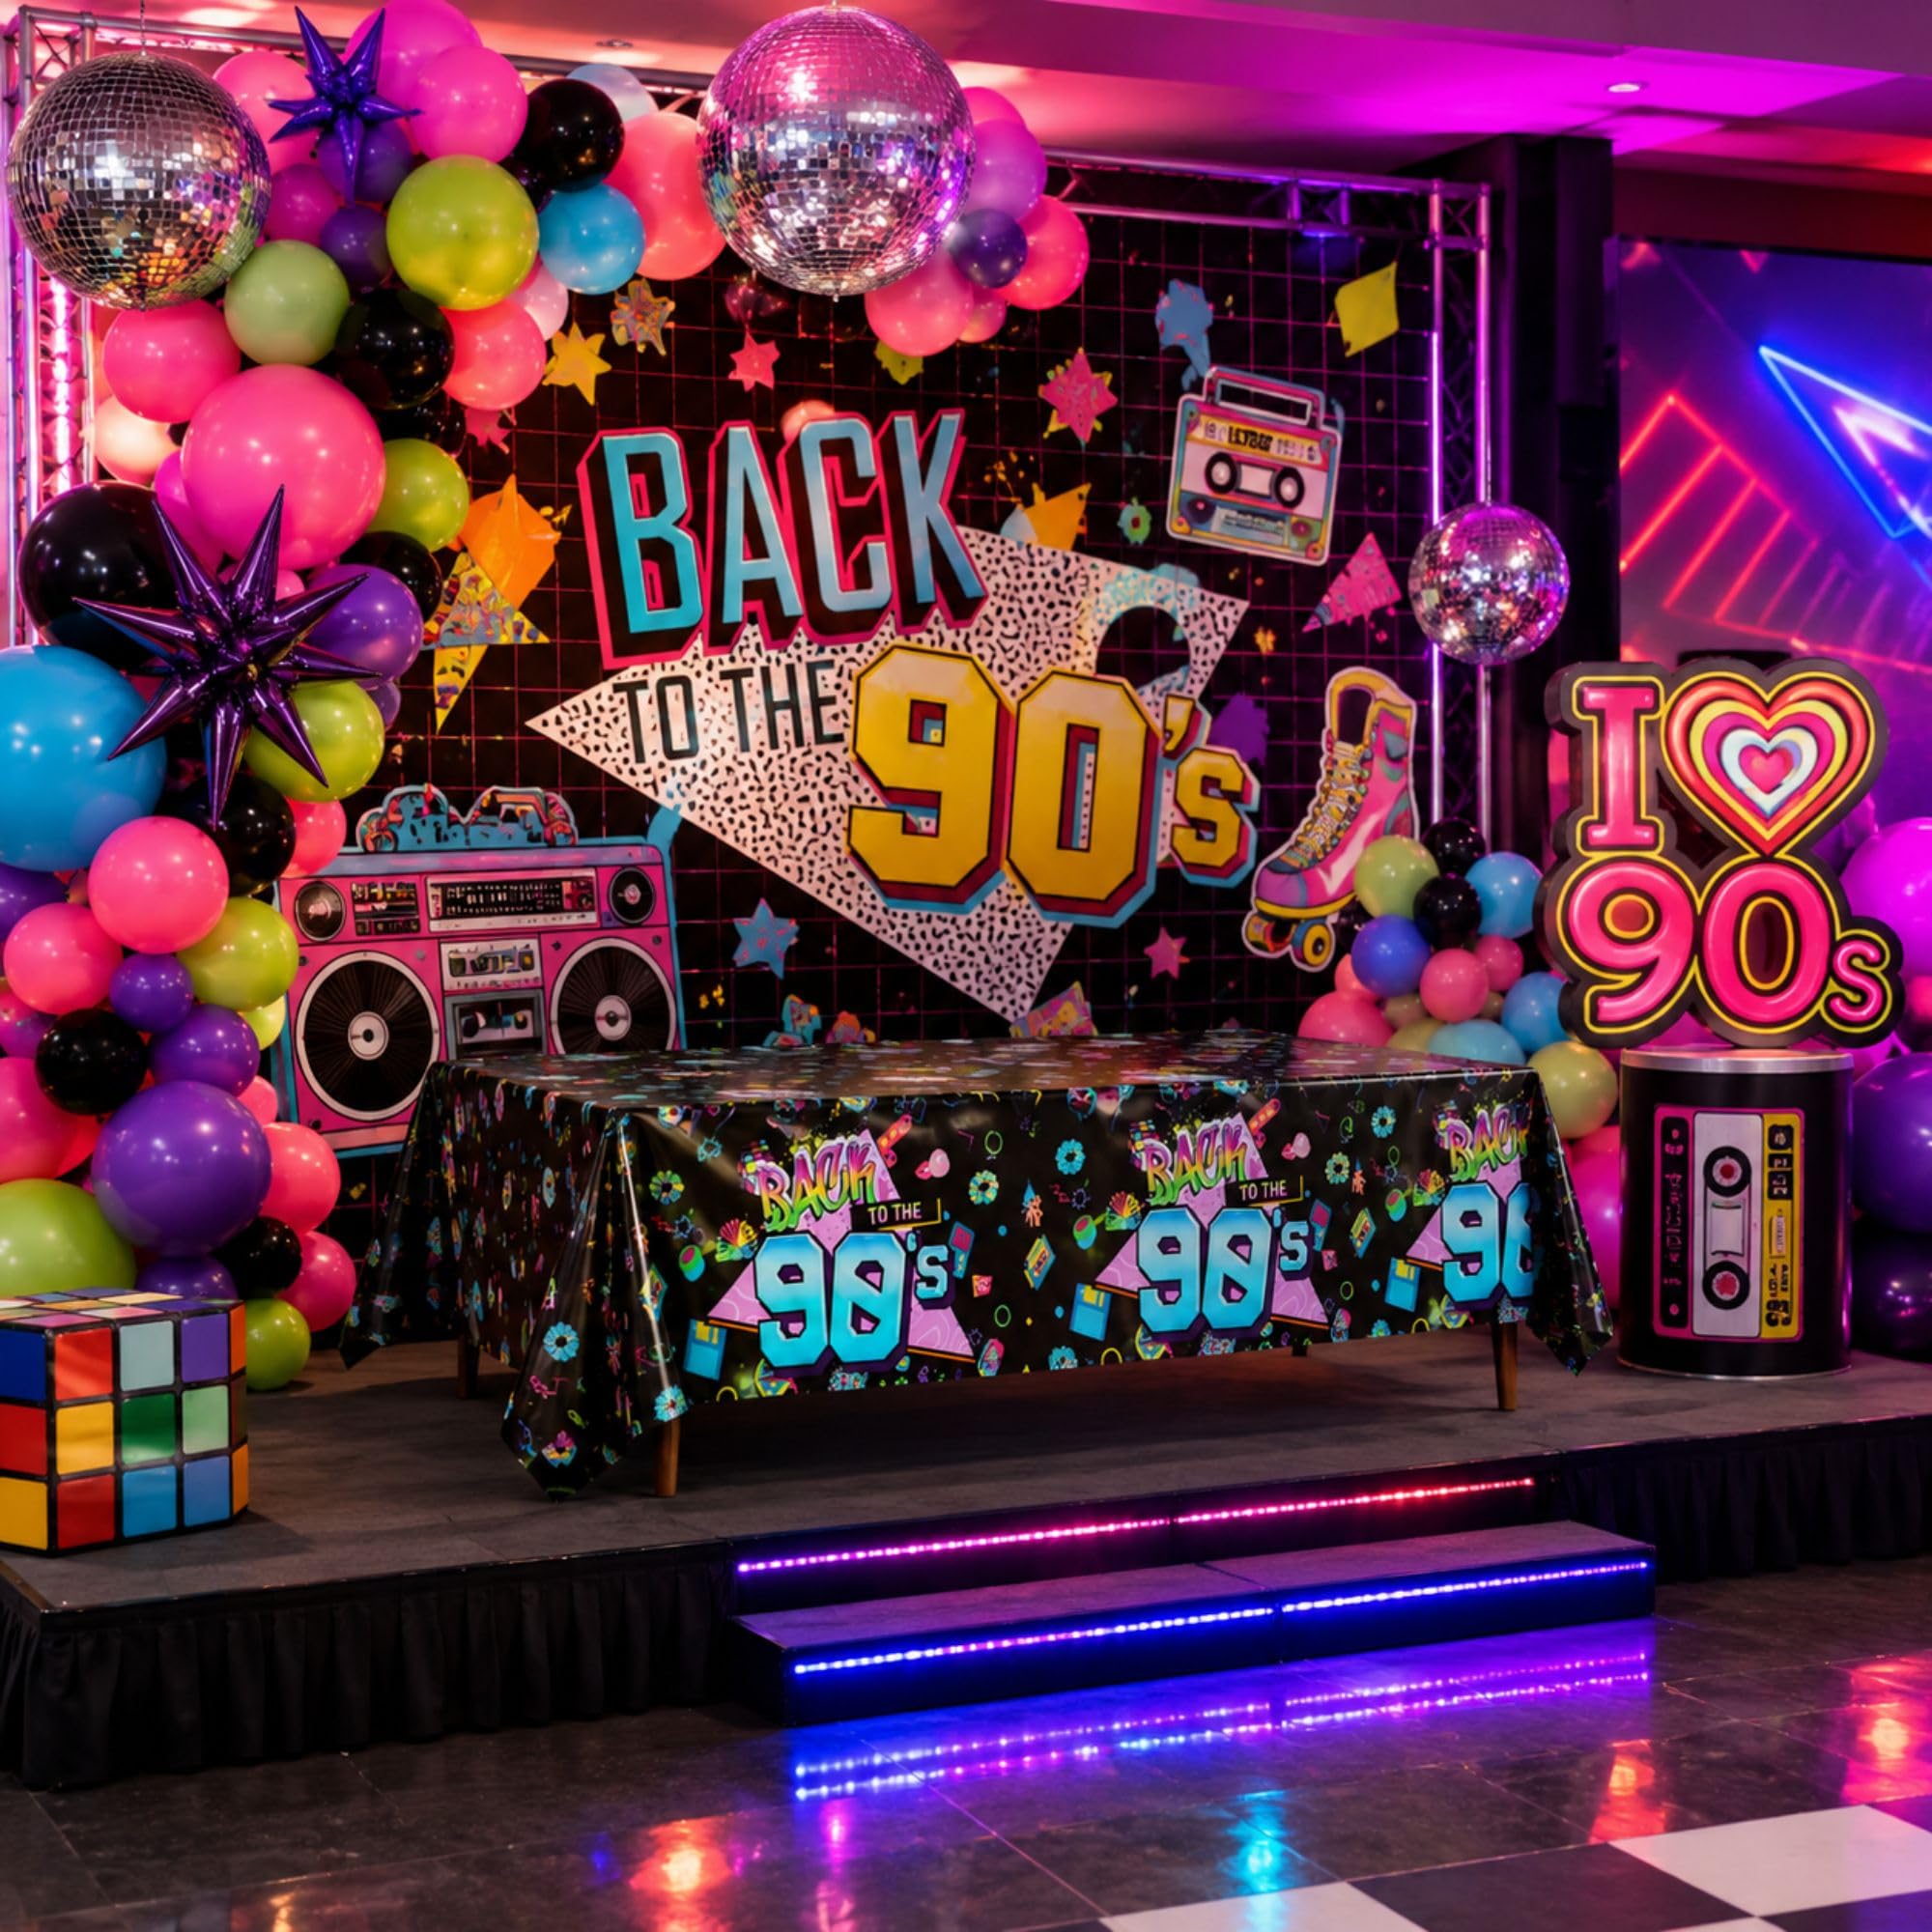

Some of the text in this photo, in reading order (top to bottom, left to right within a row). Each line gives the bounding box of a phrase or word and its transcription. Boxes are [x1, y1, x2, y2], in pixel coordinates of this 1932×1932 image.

[578, 410, 986, 668] BACK
[613, 660, 846, 763] TO THE
[1577, 680, 1661, 852] I
[1562, 857, 1889, 1031] 90s
[758, 1136, 877, 1230] BACK
[1143, 1119, 1247, 1204] BACK
[1238, 1180, 1288, 1201] TO THE
[867, 1202, 923, 1225] TO THE
